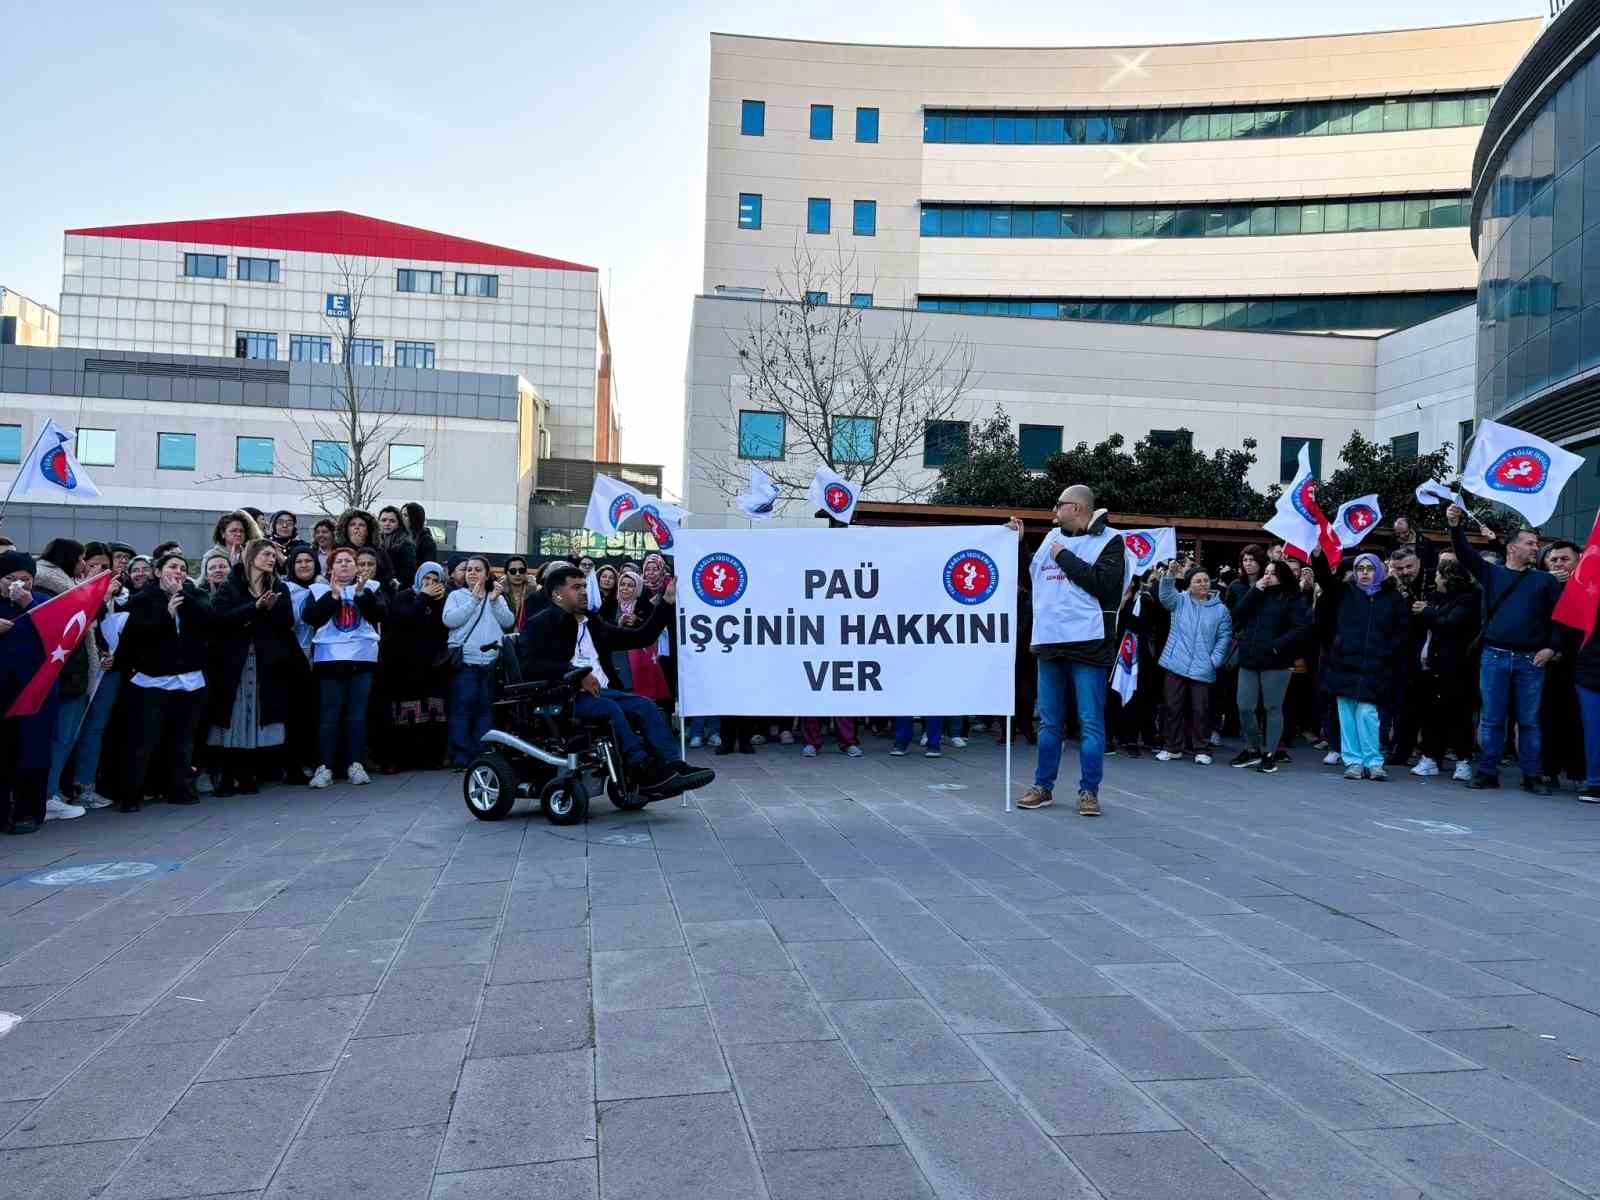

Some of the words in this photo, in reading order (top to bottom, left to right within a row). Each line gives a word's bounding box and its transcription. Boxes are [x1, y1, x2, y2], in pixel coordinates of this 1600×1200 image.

[333, 295, 345, 309] E
[804, 561, 880, 600] PAÜ
[679, 607, 826, 654] İŞÇİNİN
[839, 612, 1011, 646] HAKKINI
[802, 660, 884, 692] VER
